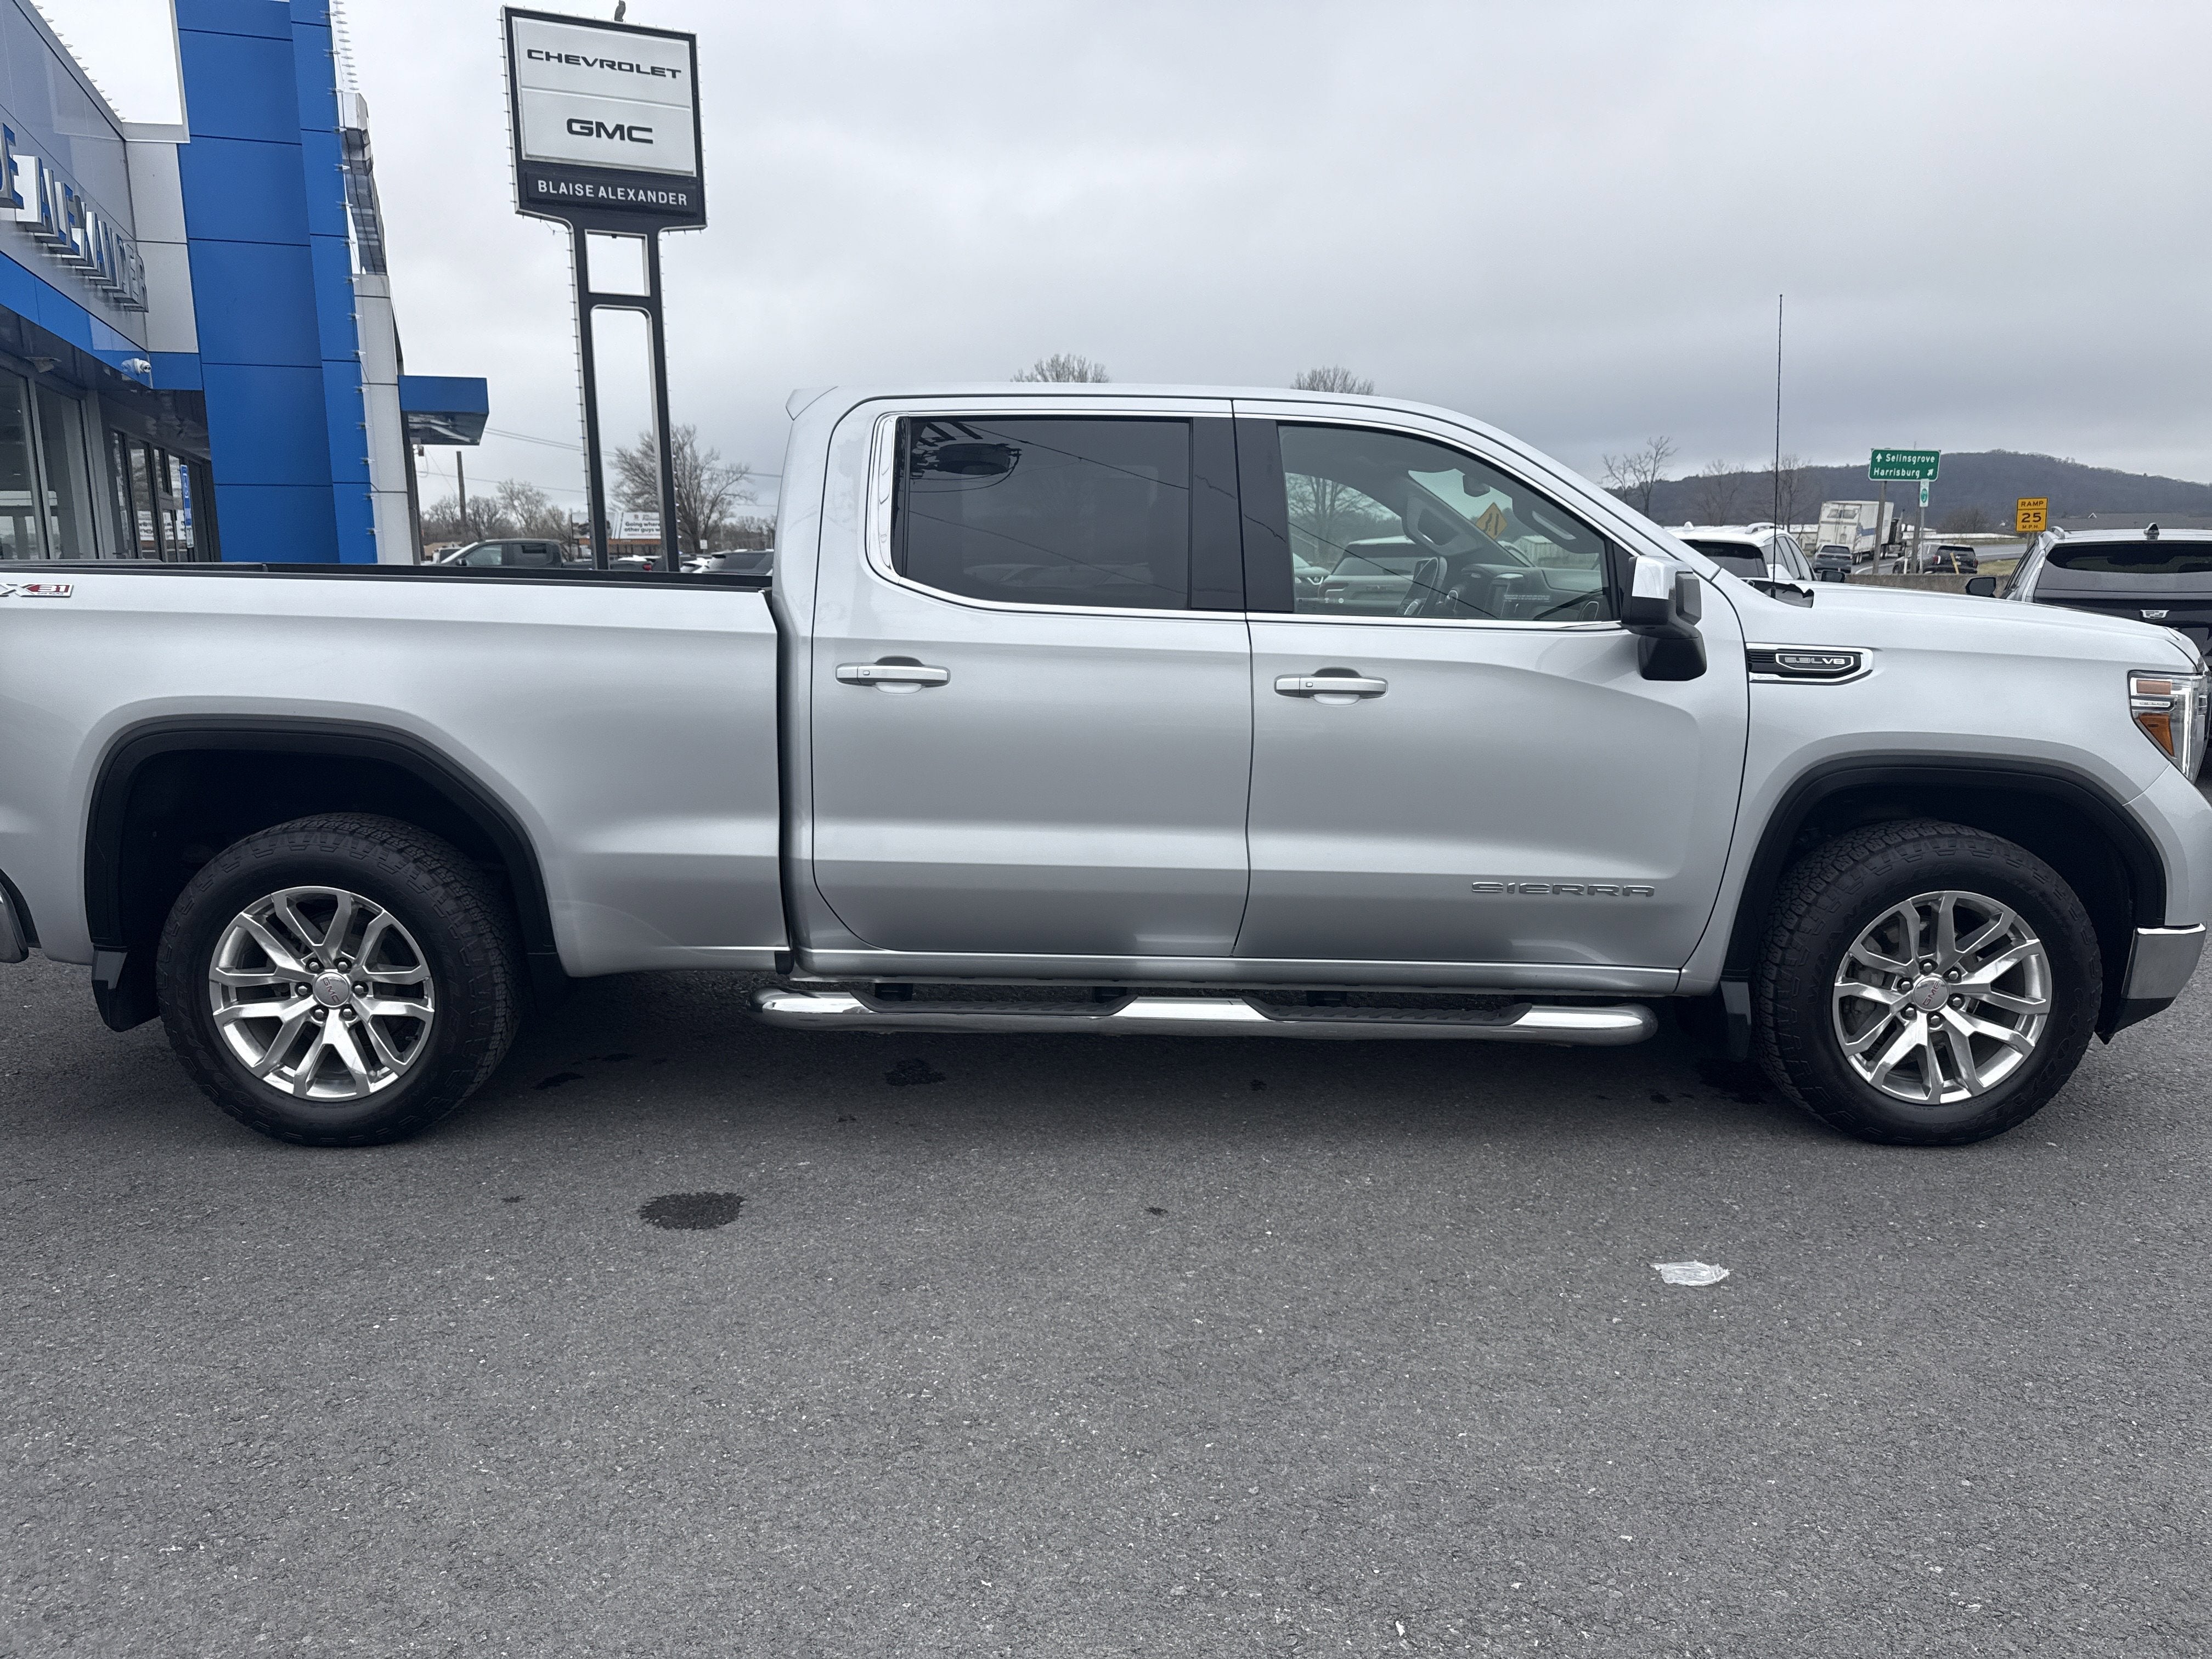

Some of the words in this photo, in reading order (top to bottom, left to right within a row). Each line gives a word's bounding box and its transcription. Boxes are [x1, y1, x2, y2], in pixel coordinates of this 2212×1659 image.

[527, 49, 681, 78] CHEVROLET
[566, 118, 653, 144] GMC
[538, 180, 595, 197] BLAISE
[598, 186, 687, 206] ALEXANDER
[1886, 453, 1935, 465] Selinsgrove
[1873, 467, 1920, 478] Harrisburg
[2021, 512, 2041, 523] 25
[1472, 882, 1655, 896] SIERRA
[323, 977, 340, 1003] GMC
[1922, 981, 1940, 1006] GMC
